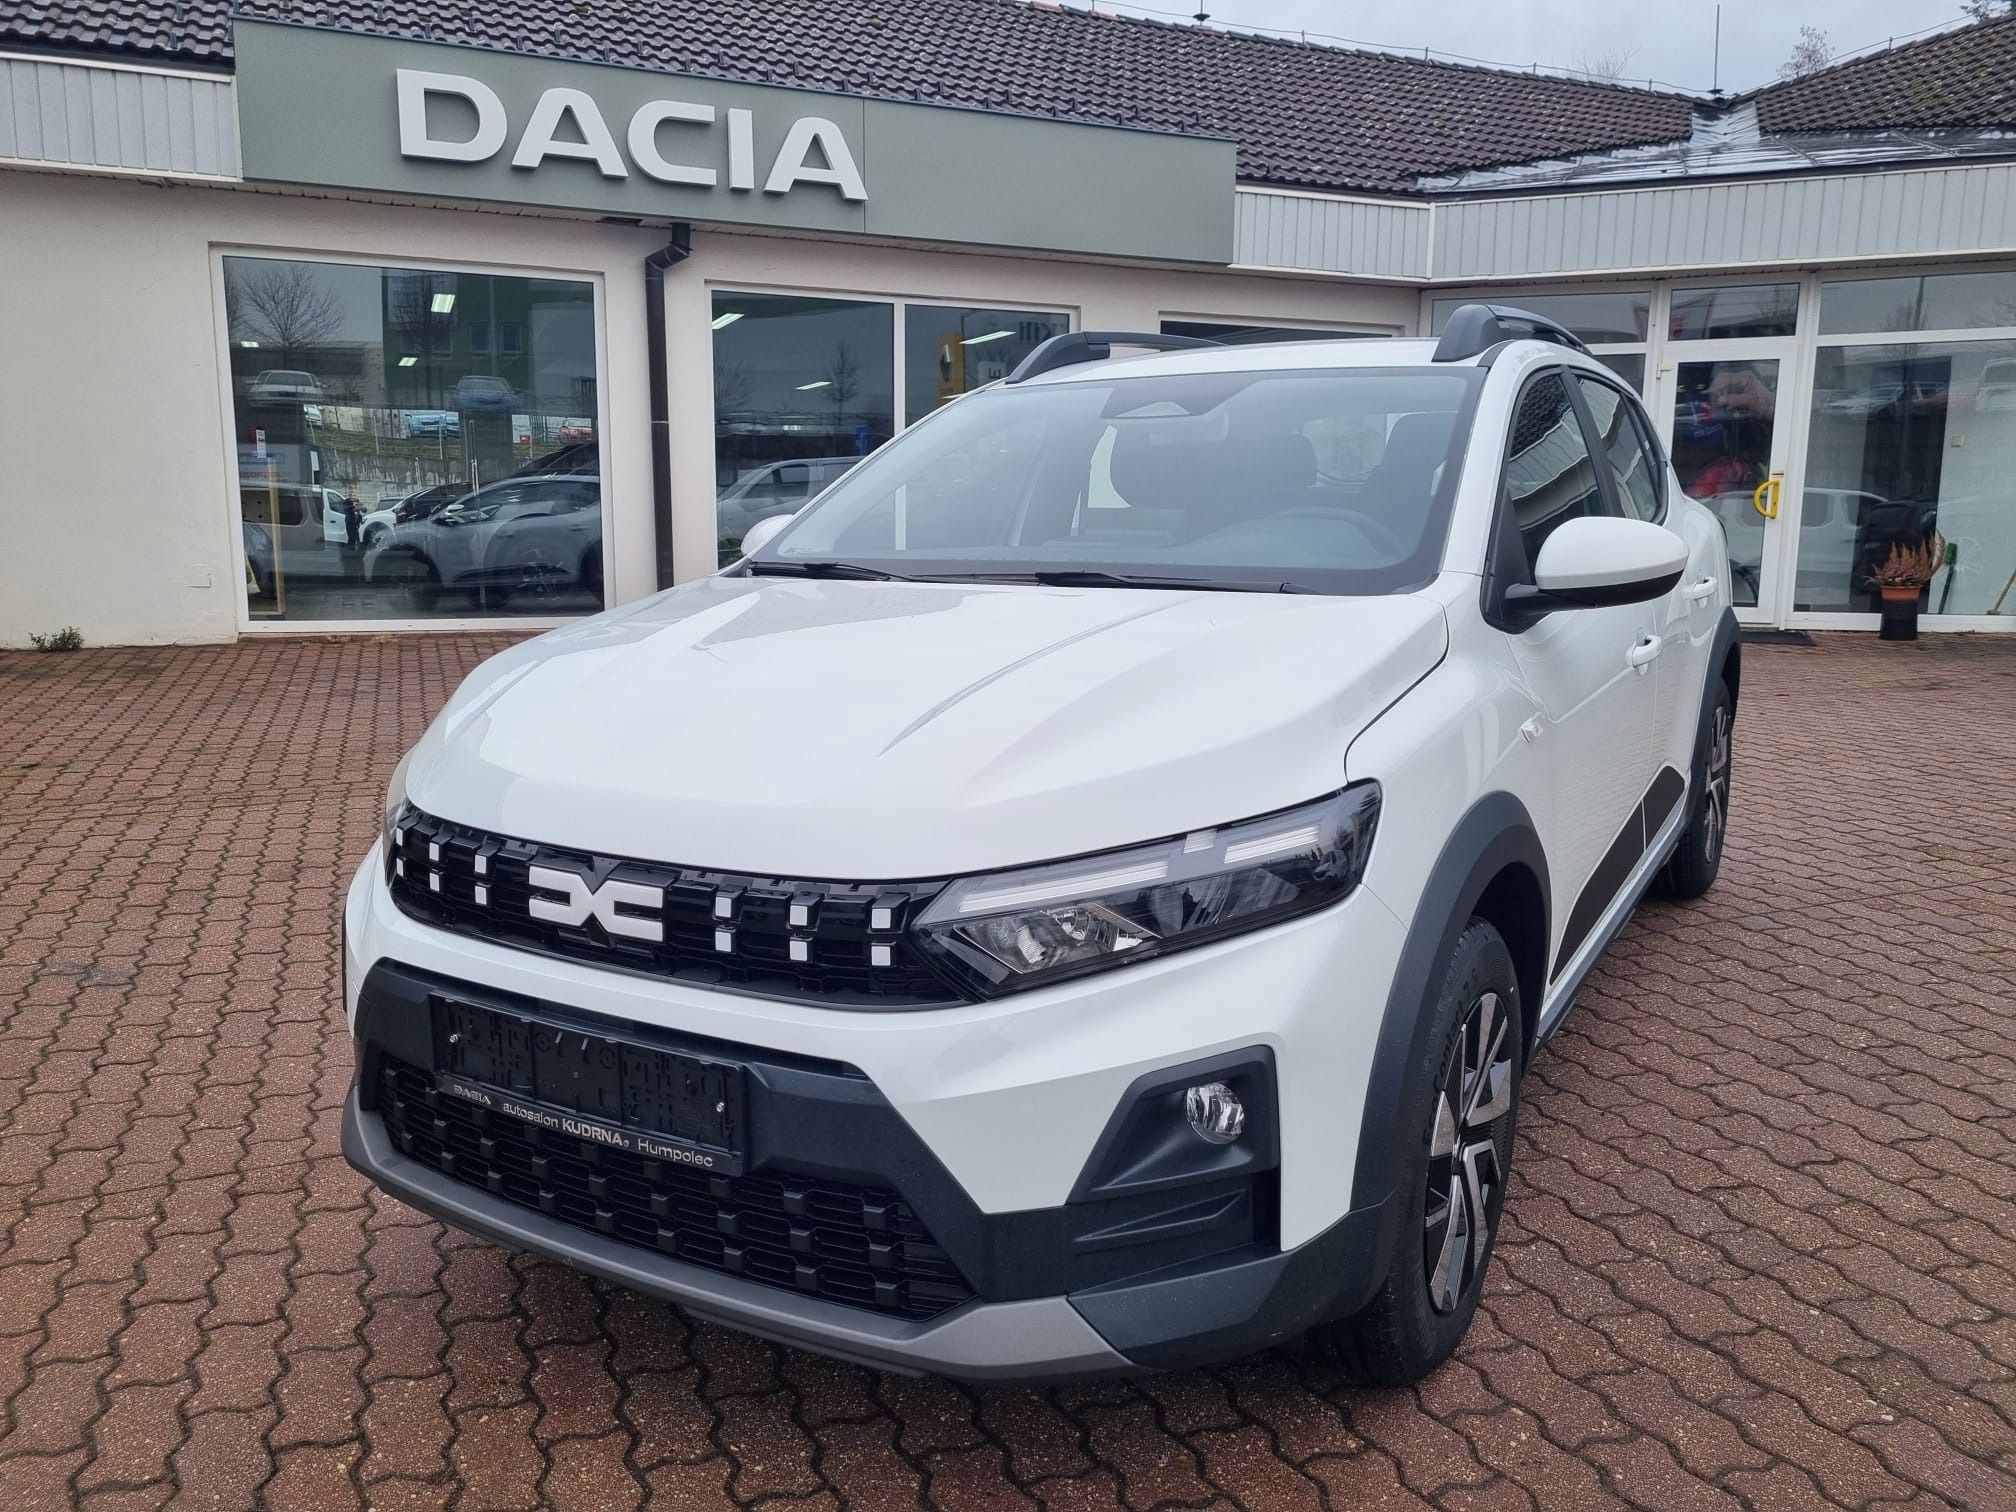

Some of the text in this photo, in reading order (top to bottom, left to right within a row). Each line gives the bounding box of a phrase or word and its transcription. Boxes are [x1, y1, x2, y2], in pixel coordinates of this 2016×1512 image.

[396, 68, 868, 201] DACIA
[503, 1102, 559, 1129] autosalon
[637, 1137, 713, 1167] Humpolec
